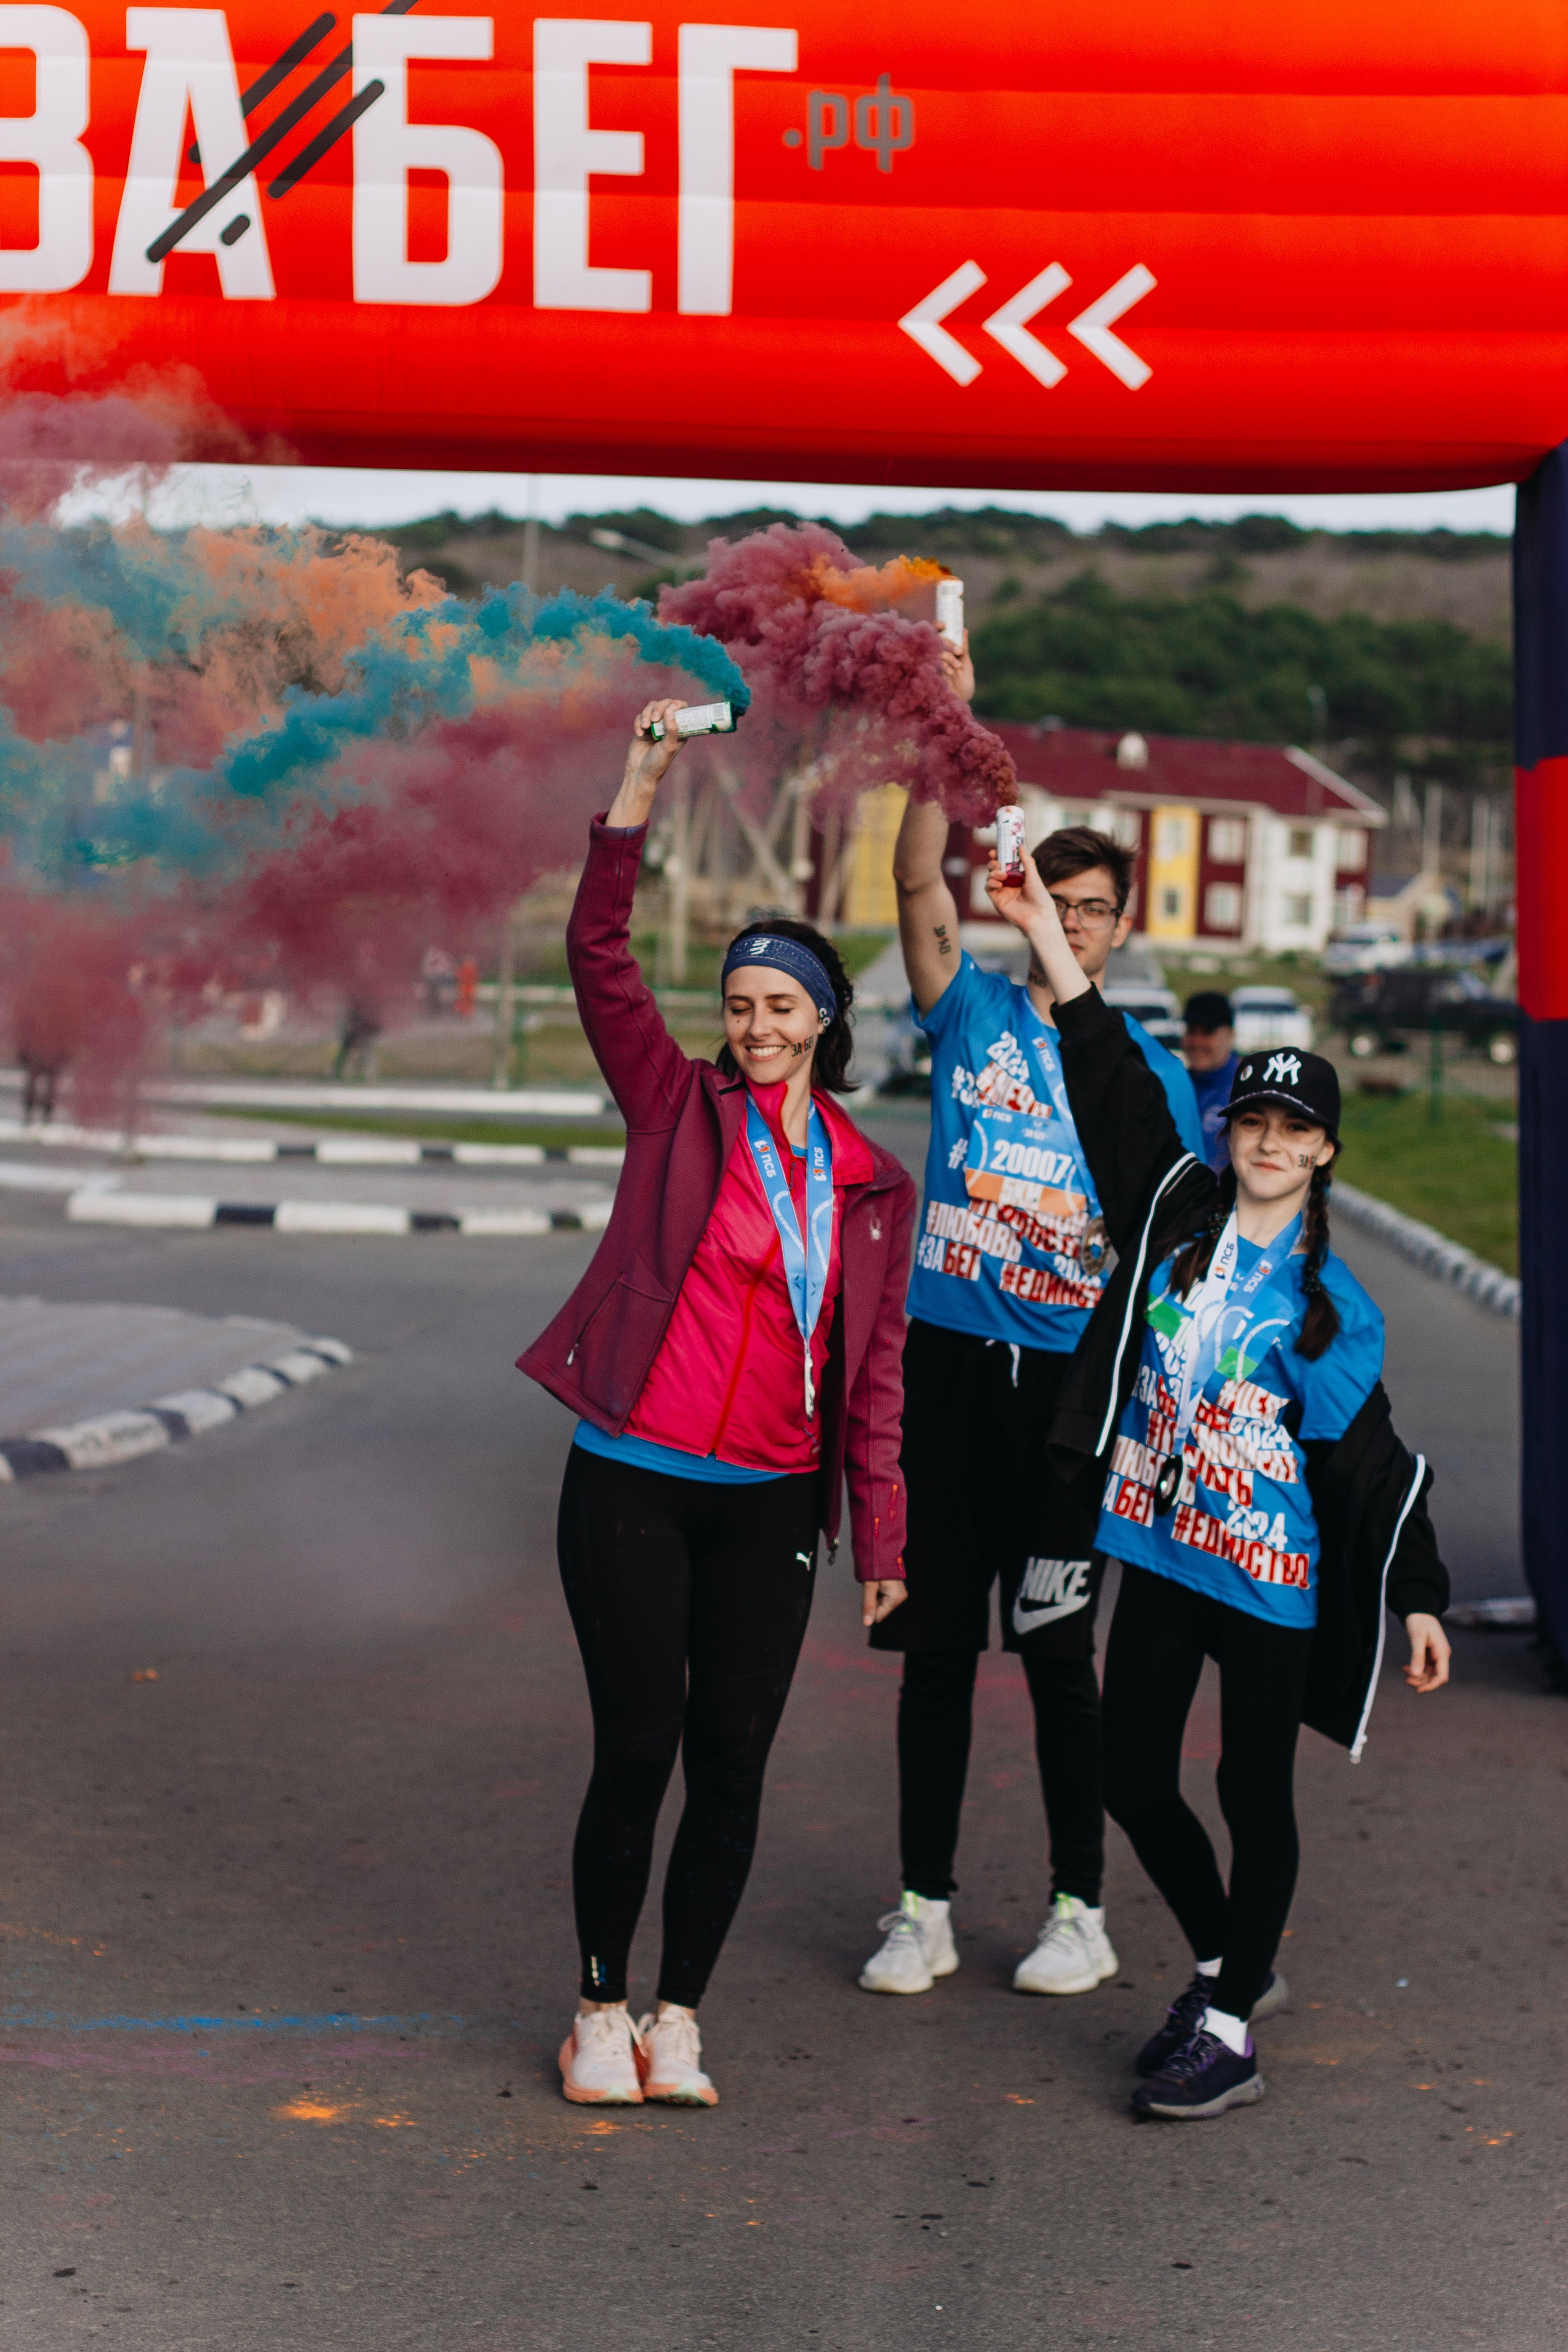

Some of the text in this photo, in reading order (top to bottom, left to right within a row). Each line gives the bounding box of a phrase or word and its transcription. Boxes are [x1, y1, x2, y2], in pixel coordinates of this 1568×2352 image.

[782, 72, 915, 174] .рф
[761, 1153, 777, 1178] ПСБ
[813, 1146, 824, 1167] ПСБ
[990, 1139, 1073, 1184] 20007
[1219, 1242, 1235, 1266] ПСБ
[1243, 1272, 1264, 1294] ПСБ
[1020, 1556, 1091, 1604] NIKE
